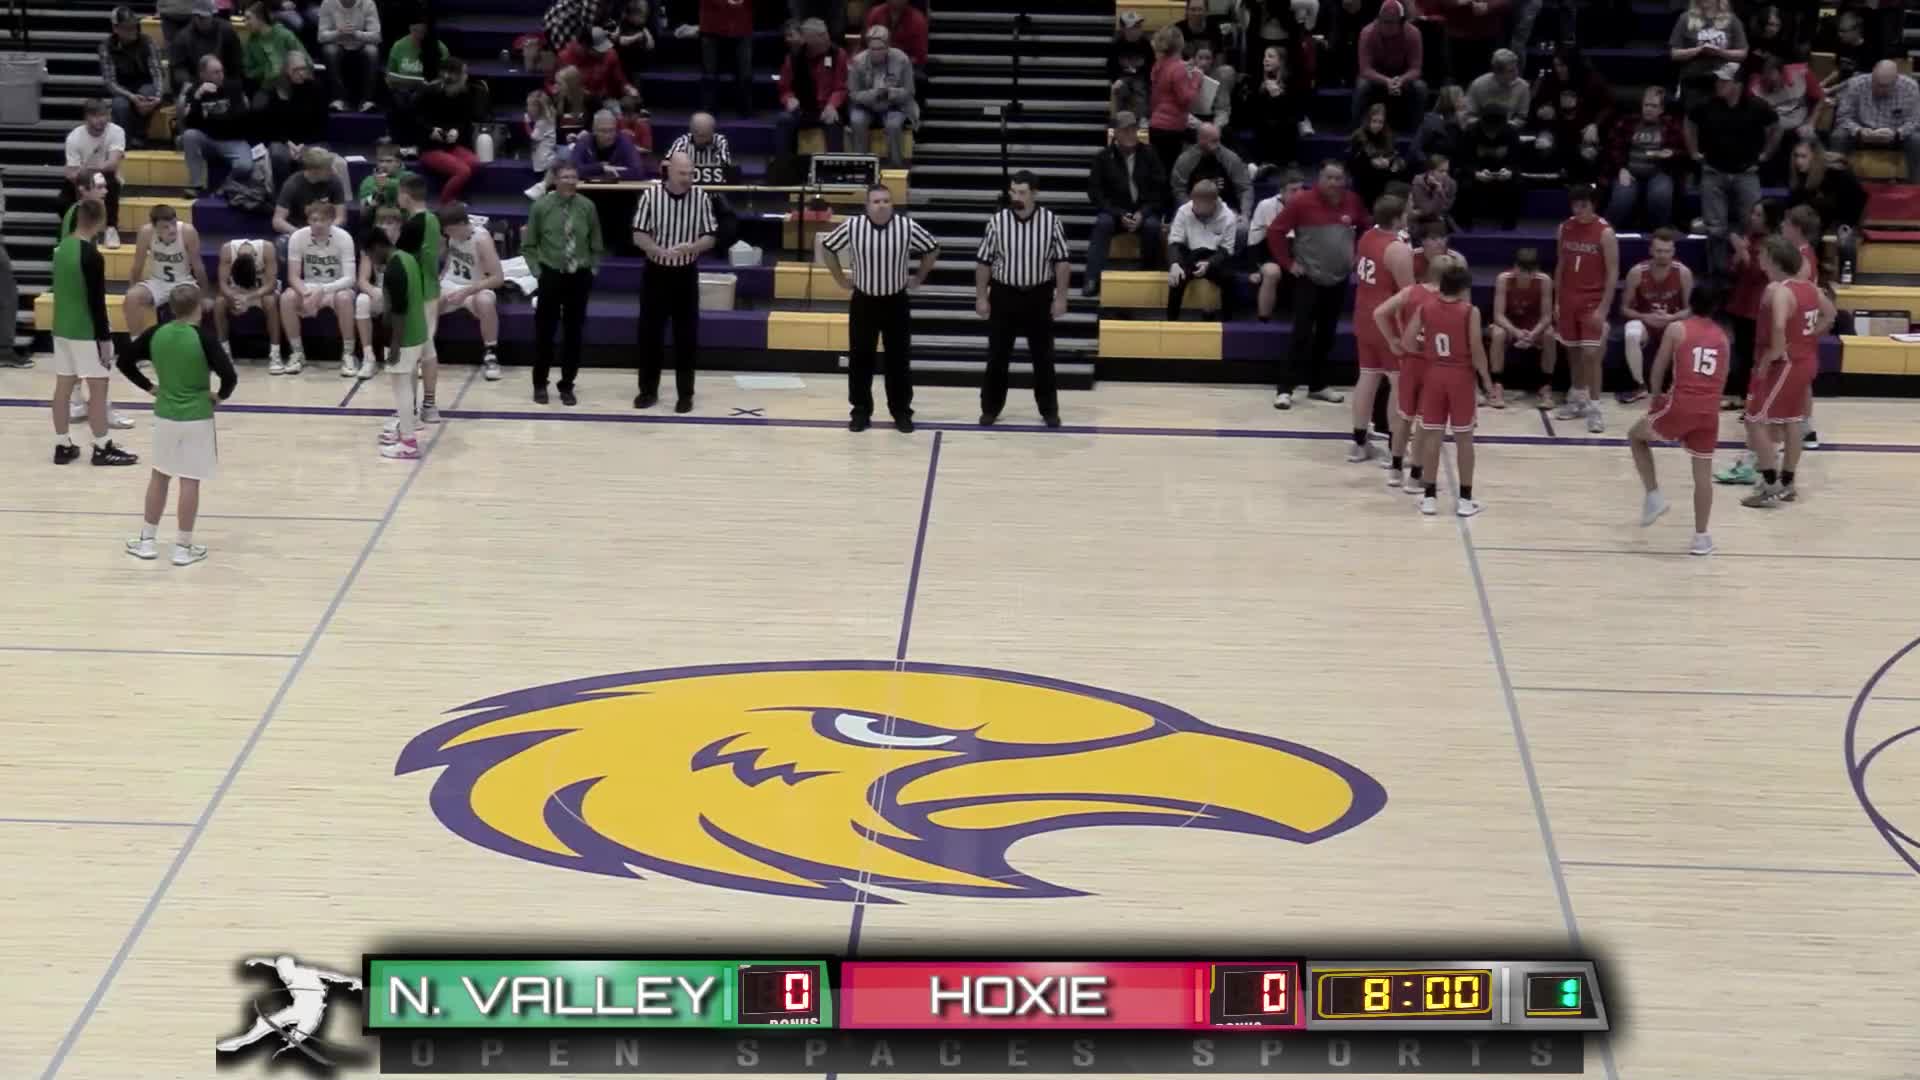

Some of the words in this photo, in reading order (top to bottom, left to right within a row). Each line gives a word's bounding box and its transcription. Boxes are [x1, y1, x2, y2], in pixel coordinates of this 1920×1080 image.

[692, 167, 727, 183] OSS.
[163, 265, 176, 283] 5
[1357, 256, 1377, 285] 42
[1574, 255, 1582, 273] 1
[1435, 332, 1451, 357] 0
[1692, 346, 1719, 376] 15
